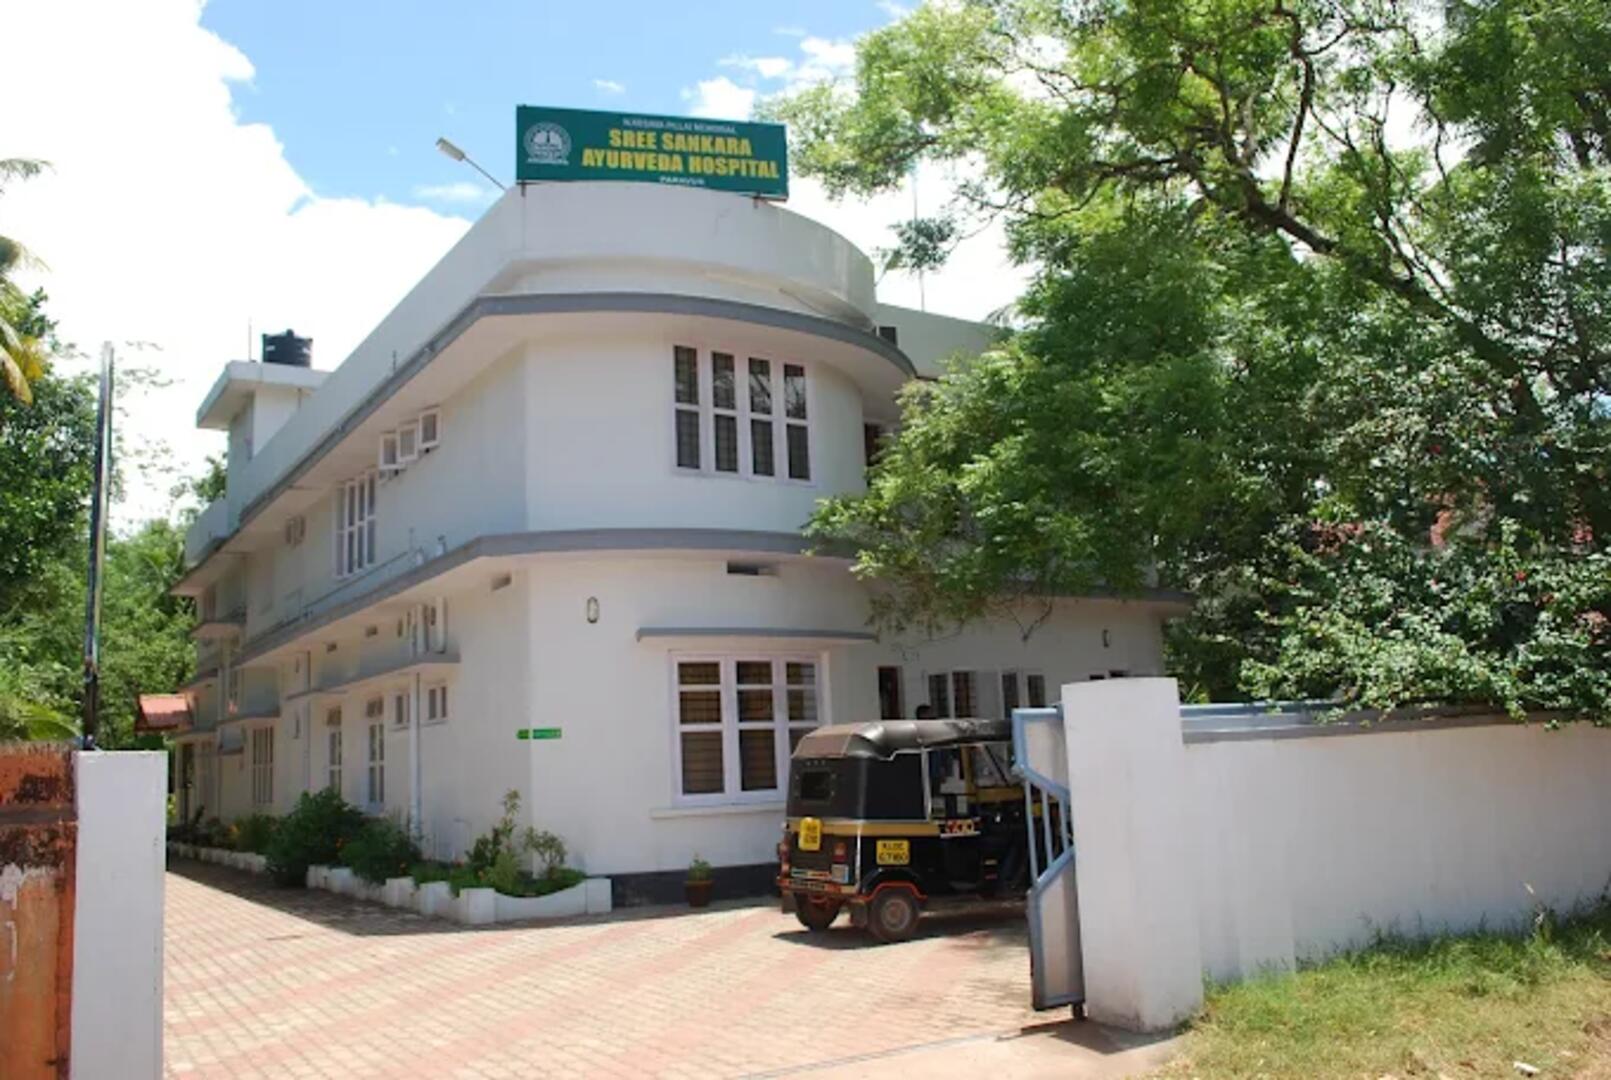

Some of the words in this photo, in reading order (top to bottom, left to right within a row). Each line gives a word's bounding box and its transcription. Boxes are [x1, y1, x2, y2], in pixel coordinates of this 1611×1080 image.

[609, 128, 657, 149] SREE
[661, 132, 752, 156] SANKARA
[581, 147, 683, 173] AYURVEDA
[688, 155, 780, 179] HOSPITAL
